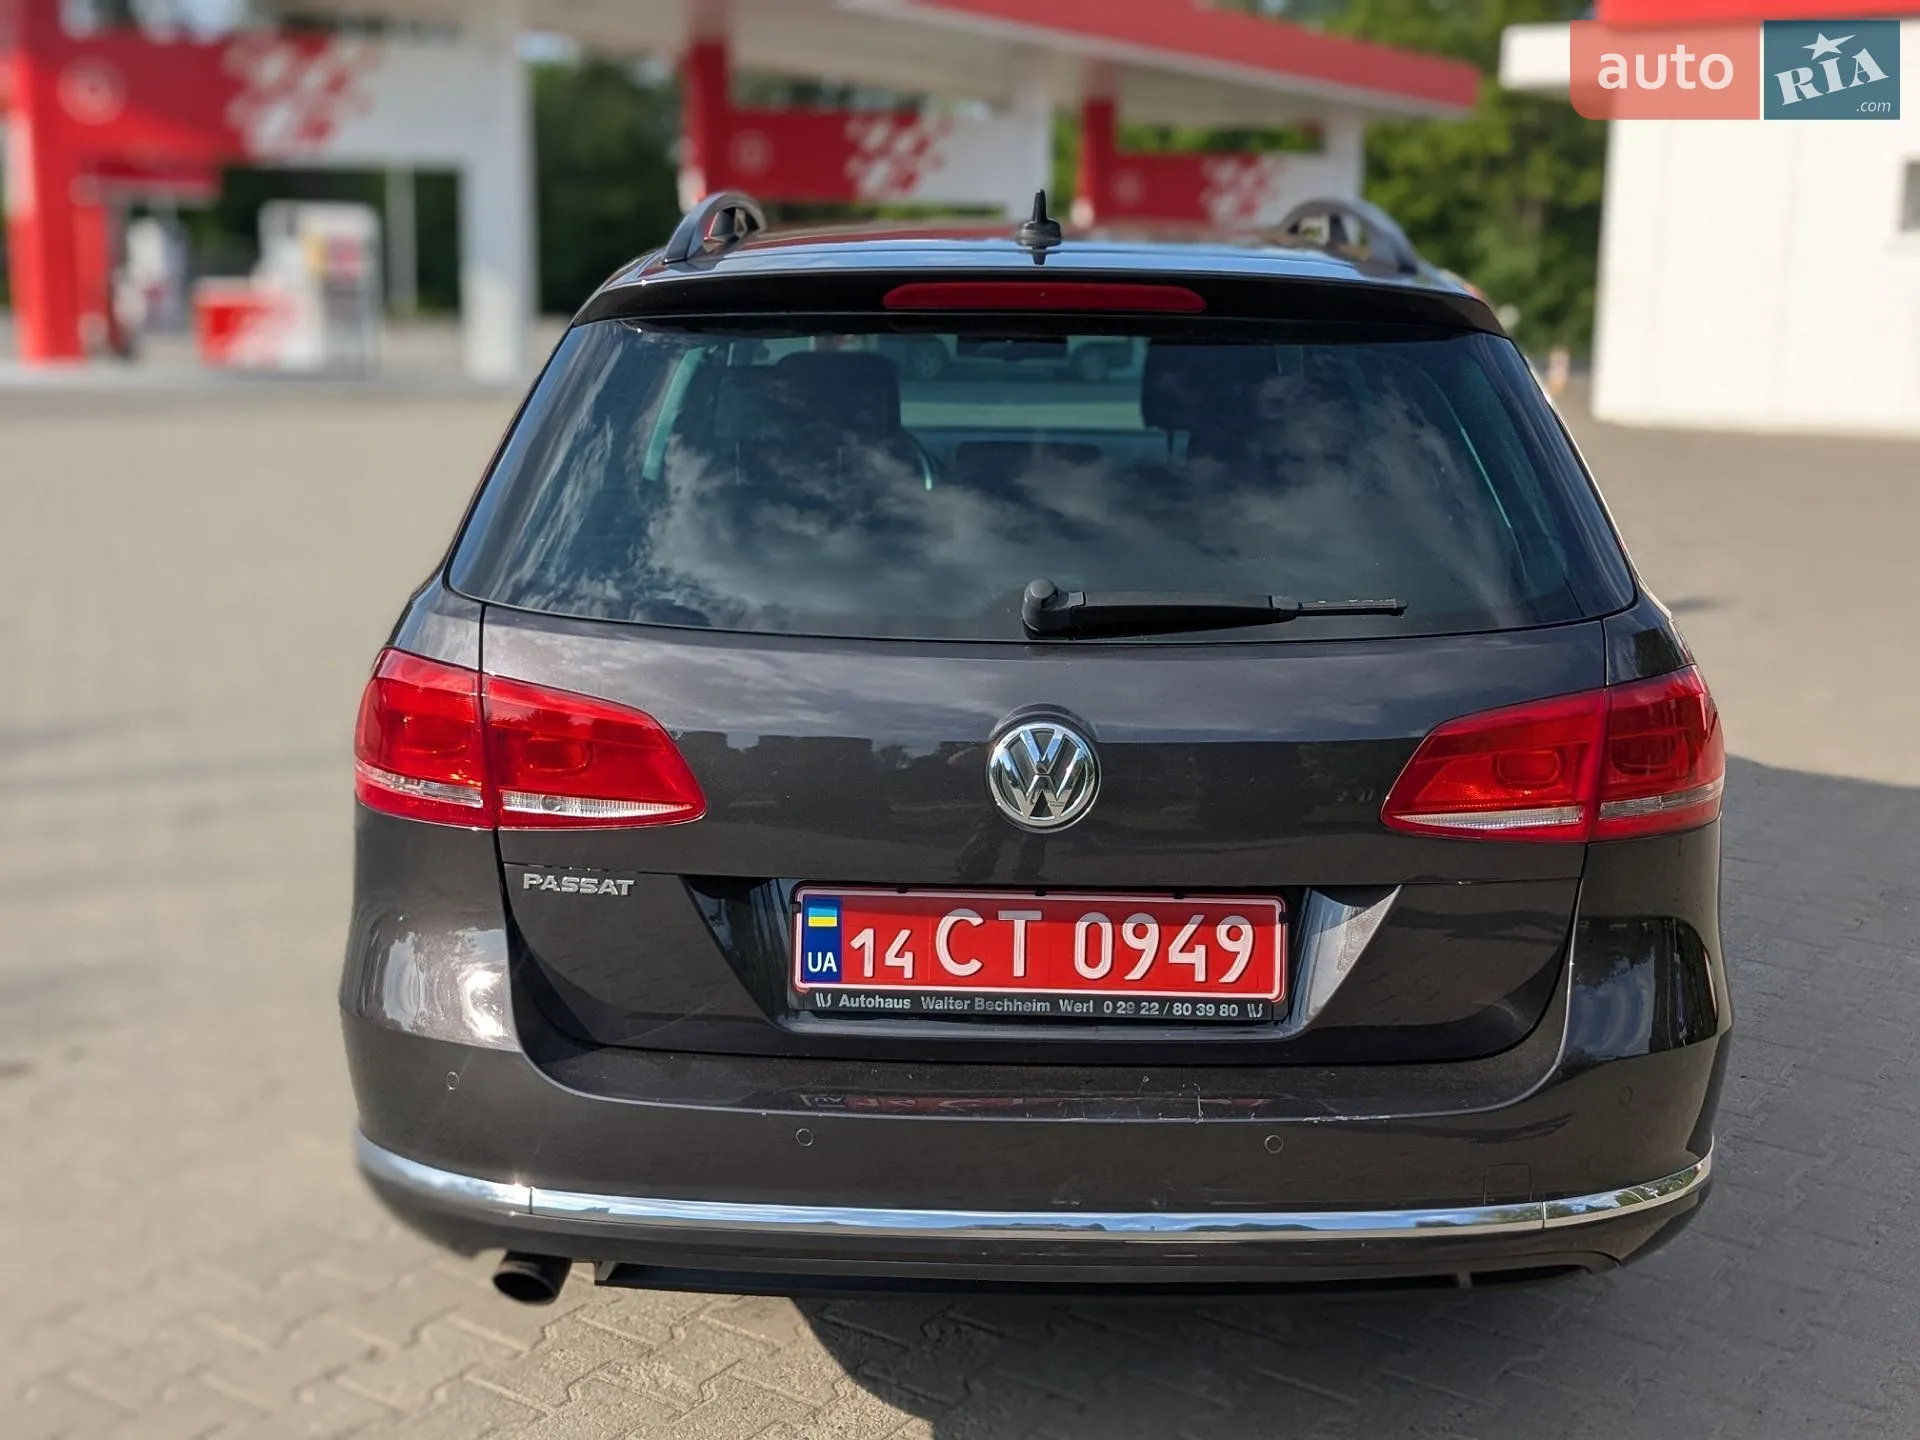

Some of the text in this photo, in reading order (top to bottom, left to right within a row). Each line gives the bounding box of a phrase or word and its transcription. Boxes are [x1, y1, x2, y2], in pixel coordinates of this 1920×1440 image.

[523, 873, 635, 896] PASSAT
[850, 908, 1254, 983] 14 CT 0949
[807, 951, 837, 973] UA
[838, 993, 912, 1010] Autohaus
[921, 996, 971, 1011] Walter
[974, 997, 1050, 1013] Bechheim
[1059, 999, 1094, 1013] Werl
[1140, 1001, 1160, 1015] 22
[1172, 1002, 1192, 1016] 80
[1195, 1003, 1215, 1017] 39
[1219, 1003, 1239, 1017] 80
